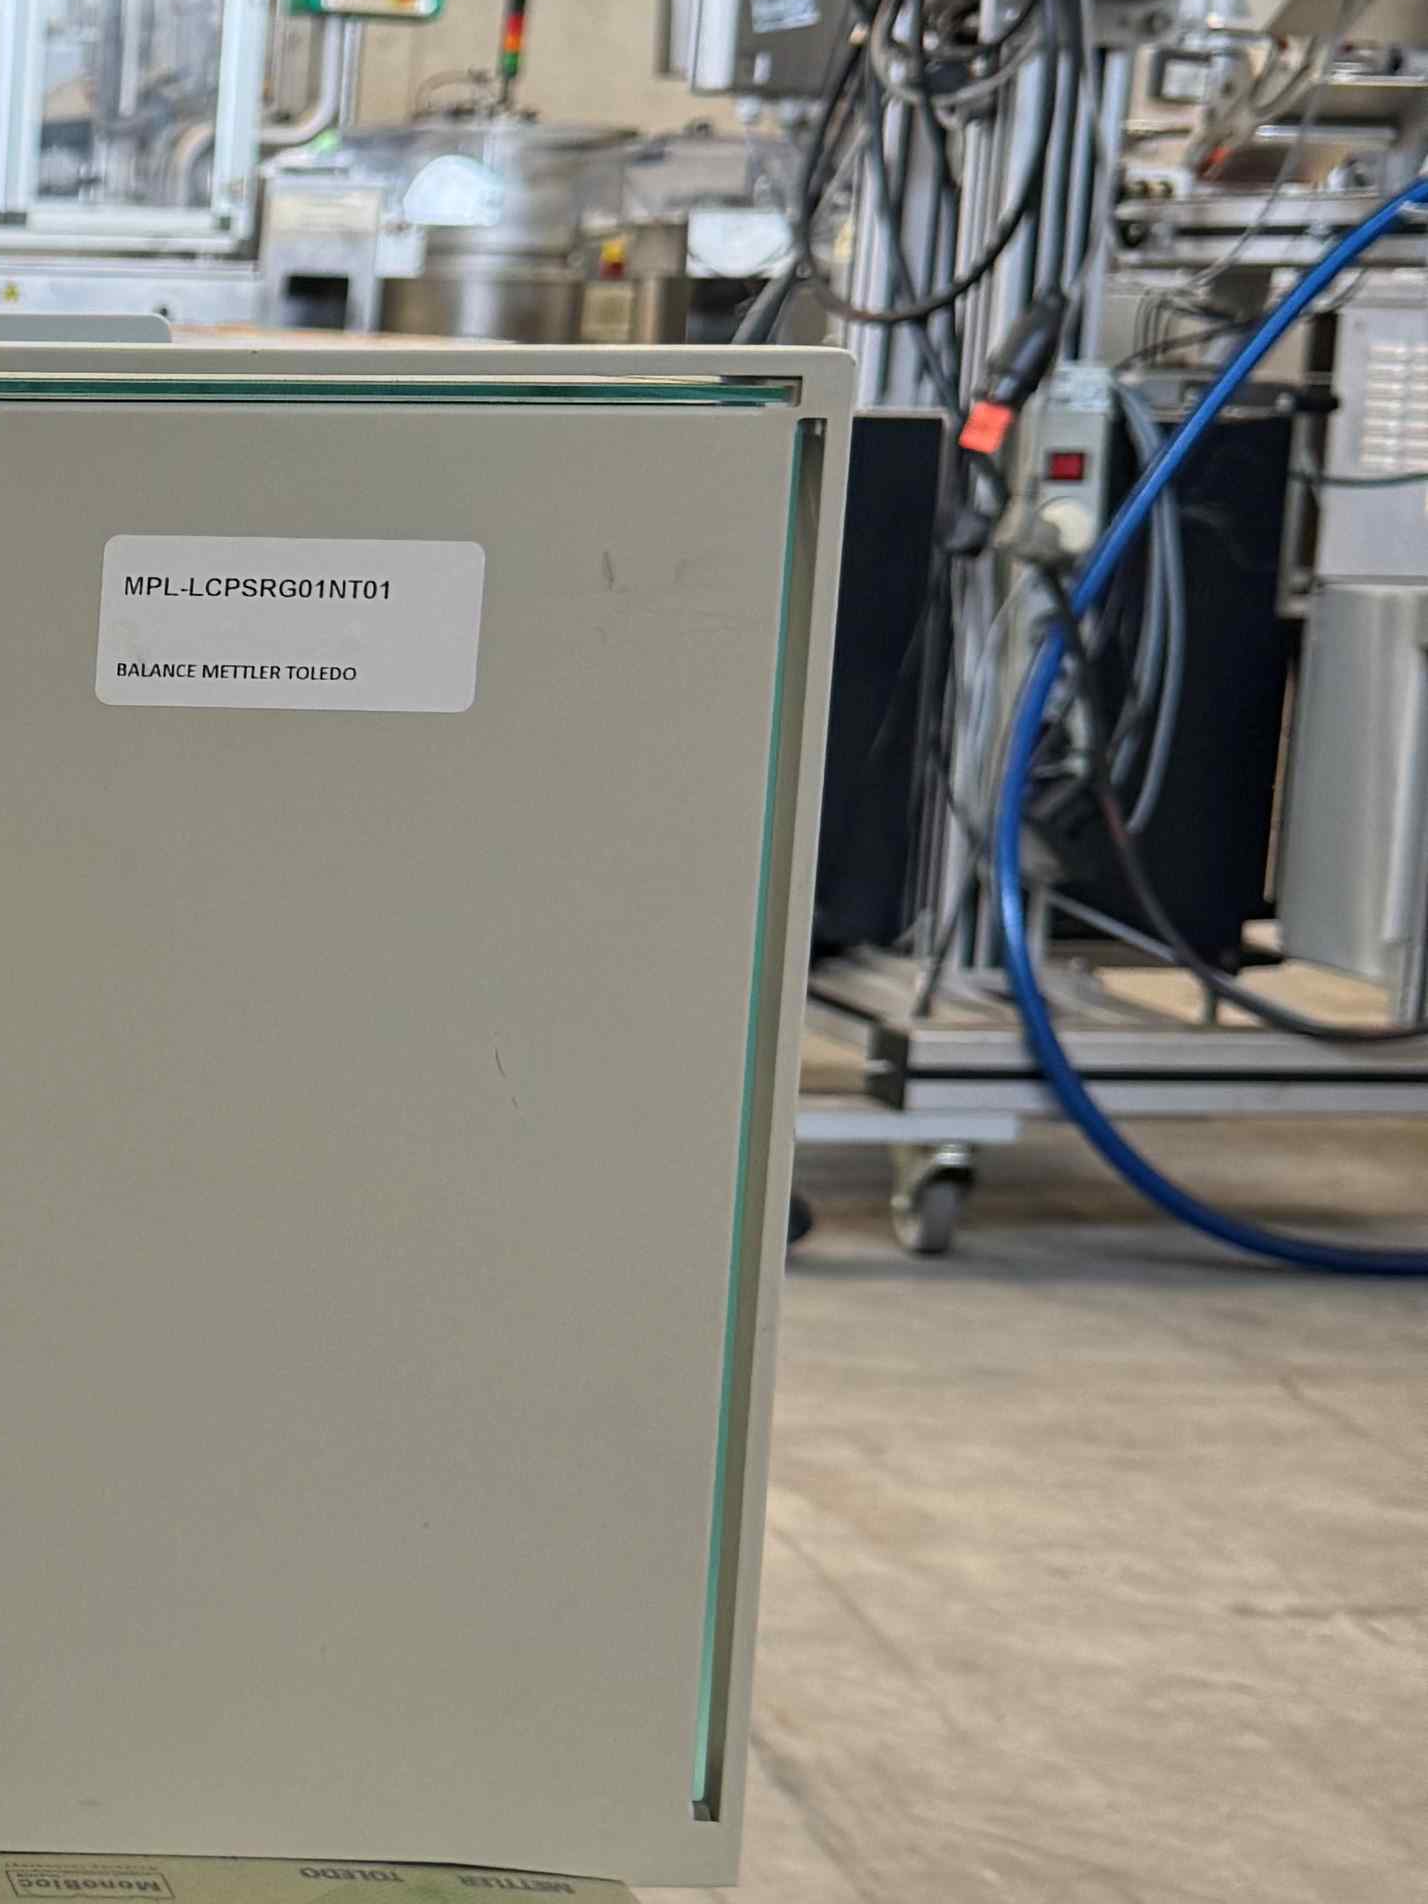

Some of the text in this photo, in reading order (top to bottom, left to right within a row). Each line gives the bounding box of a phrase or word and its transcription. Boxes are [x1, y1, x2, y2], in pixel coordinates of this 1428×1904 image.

[124, 576, 390, 600] MPL-LCPSRG01NT01
[116, 662, 357, 681] BALANCE METTLER TOLEDO
[19, 1878, 162, 1892] MonoBloc
[299, 1867, 576, 1894] METTLER TOLEDO
